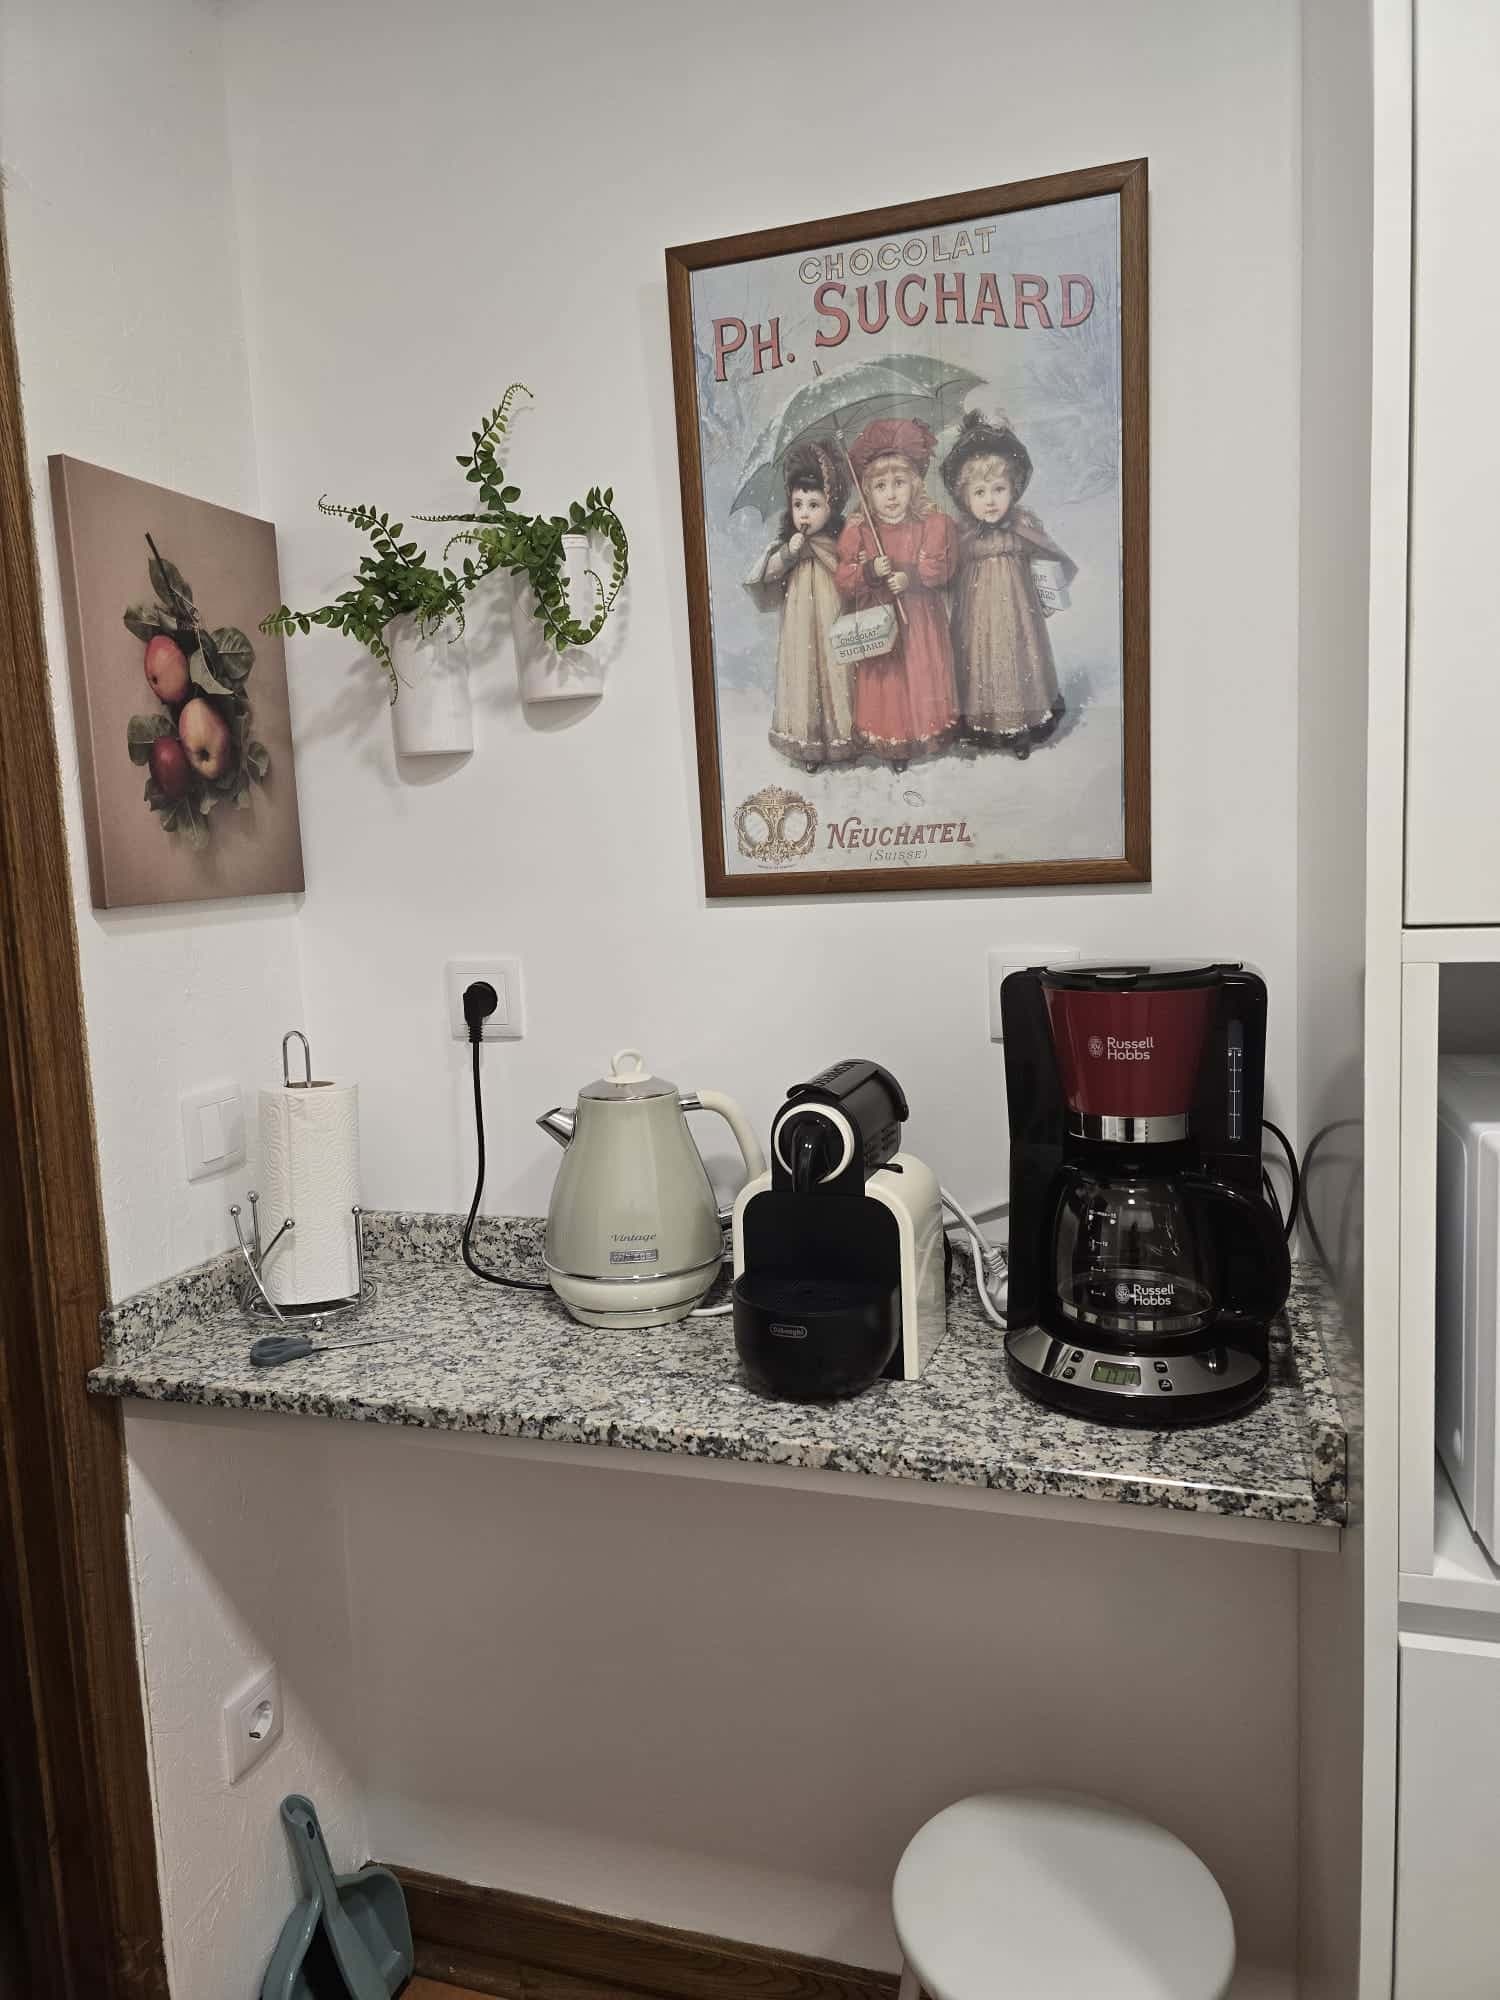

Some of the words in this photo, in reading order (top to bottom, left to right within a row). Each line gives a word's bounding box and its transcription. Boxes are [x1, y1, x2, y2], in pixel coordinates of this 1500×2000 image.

[799, 225, 997, 285] CHOCOLAT
[712, 316, 796, 382] PH.
[813, 272, 1096, 348] SUCHARD
[1107, 1036, 1154, 1049] Russell
[1107, 1049, 1151, 1061] Hobbs
[1133, 1283, 1175, 1295] Russell
[1133, 1295, 1172, 1306] Hobbs
